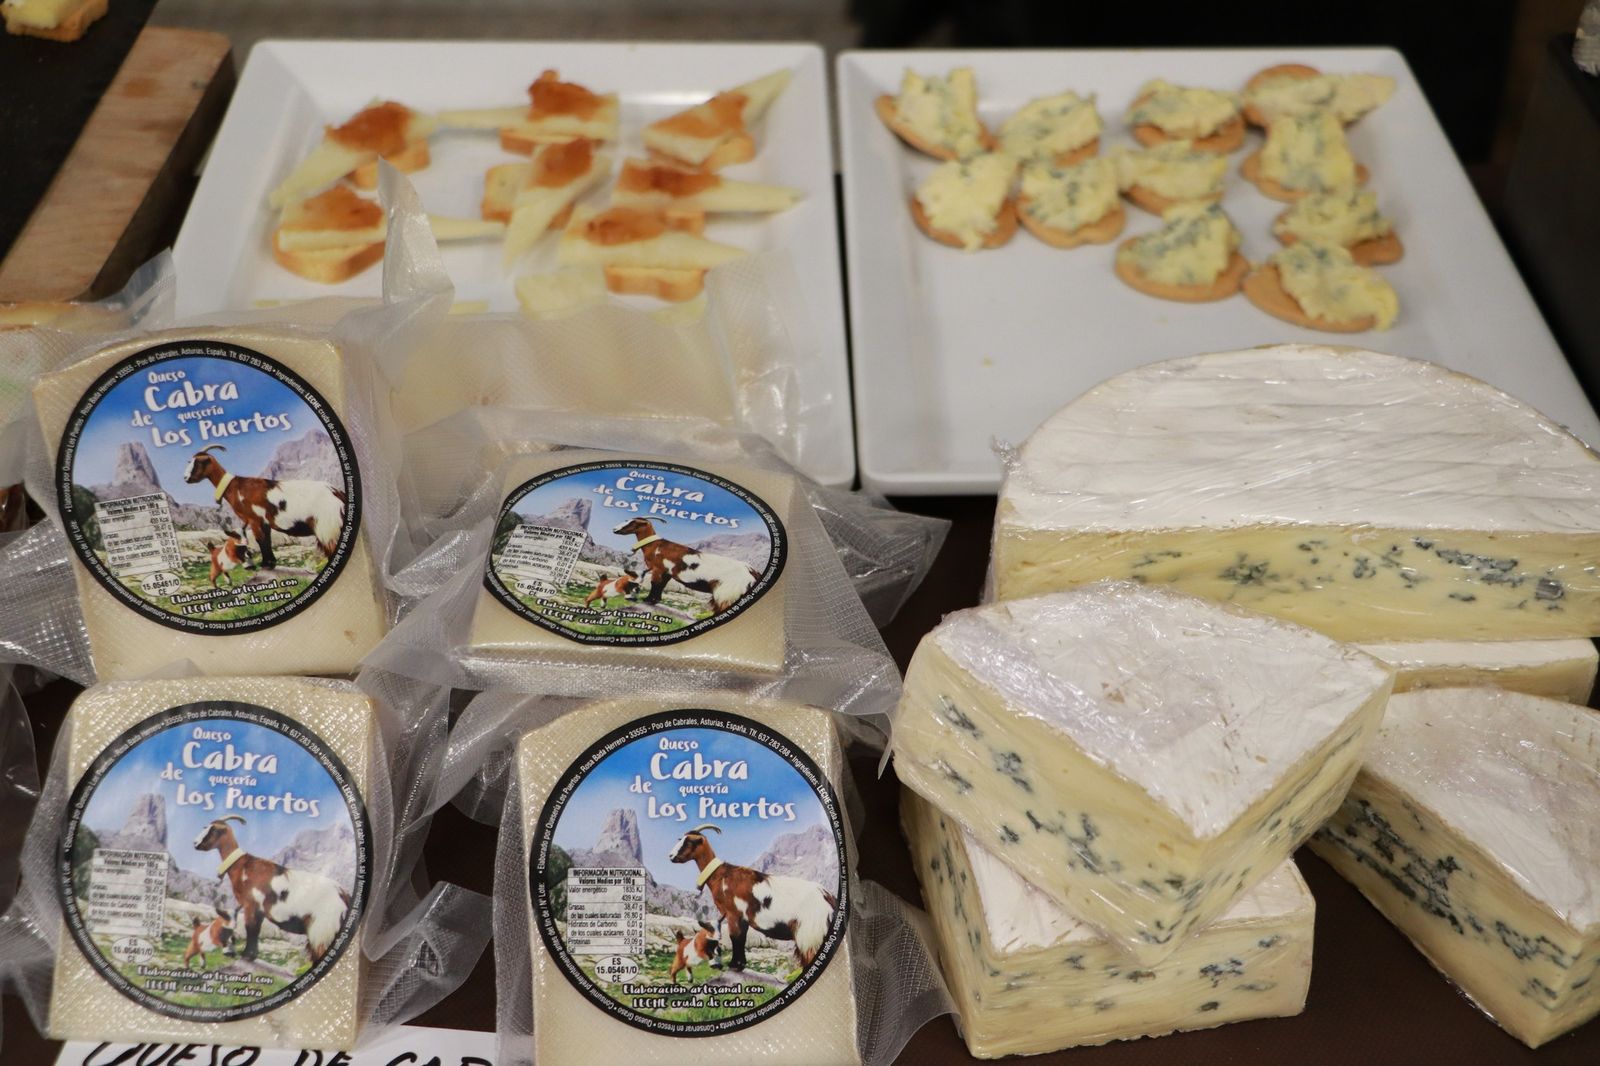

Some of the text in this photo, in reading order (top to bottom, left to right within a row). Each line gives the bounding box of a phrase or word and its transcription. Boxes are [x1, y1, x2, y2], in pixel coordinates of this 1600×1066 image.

[149, 370, 186, 384] Queso
[144, 381, 239, 411] Cabra
[131, 406, 224, 427] de quesería
[152, 411, 292, 448] Los Puertos
[629, 470, 664, 481] Queso
[593, 484, 682, 506] de quesería
[616, 477, 704, 503] Cabra
[603, 495, 740, 529] Los Puertos
[231, 581, 278, 596] artesanal
[281, 578, 299, 587] con
[217, 597, 247, 609] cruda
[249, 595, 263, 604] de
[264, 590, 291, 601] cabra
[579, 616, 610, 626] cruda
[613, 619, 628, 627] de
[629, 621, 659, 632] cabra
[653, 615, 672, 624] con
[193, 727, 232, 741] Queso
[628, 717, 791, 757] 33555 Poo de Cabrales, Asturias, España. Tlf. 637 283 288
[660, 738, 698, 752] Queso
[182, 742, 277, 774] Cabra
[651, 754, 748, 780] Cabra
[161, 763, 257, 786] de quesería
[630, 779, 728, 795] de quesería
[789, 755, 841, 828] Ingredientes: LECHE cruda de
[177, 783, 320, 817] Los Puertos
[537, 734, 626, 869] Elaborado por Quesería Los Puertos Rosa Bada Herrero
[648, 796, 796, 821] Los Puertos
[785, 933, 835, 996] Origen de la leche: España
[256, 976, 273, 984] con
[623, 984, 764, 996] Elaboración artesanal con
[183, 984, 213, 994] cruda
[217, 985, 230, 995] de
[233, 987, 263, 997] cabra
[672, 997, 703, 1008] cruda
[707, 997, 721, 1008] de
[724, 997, 754, 1008] cabra
[755, 996, 784, 1017] Contenido
[616, 1005, 652, 1026] Queso Graso
[719, 1019, 735, 1029] venta
[743, 1011, 757, 1023] neto
[656, 1021, 675, 1031] fresco
[685, 1024, 714, 1032] Conservar
